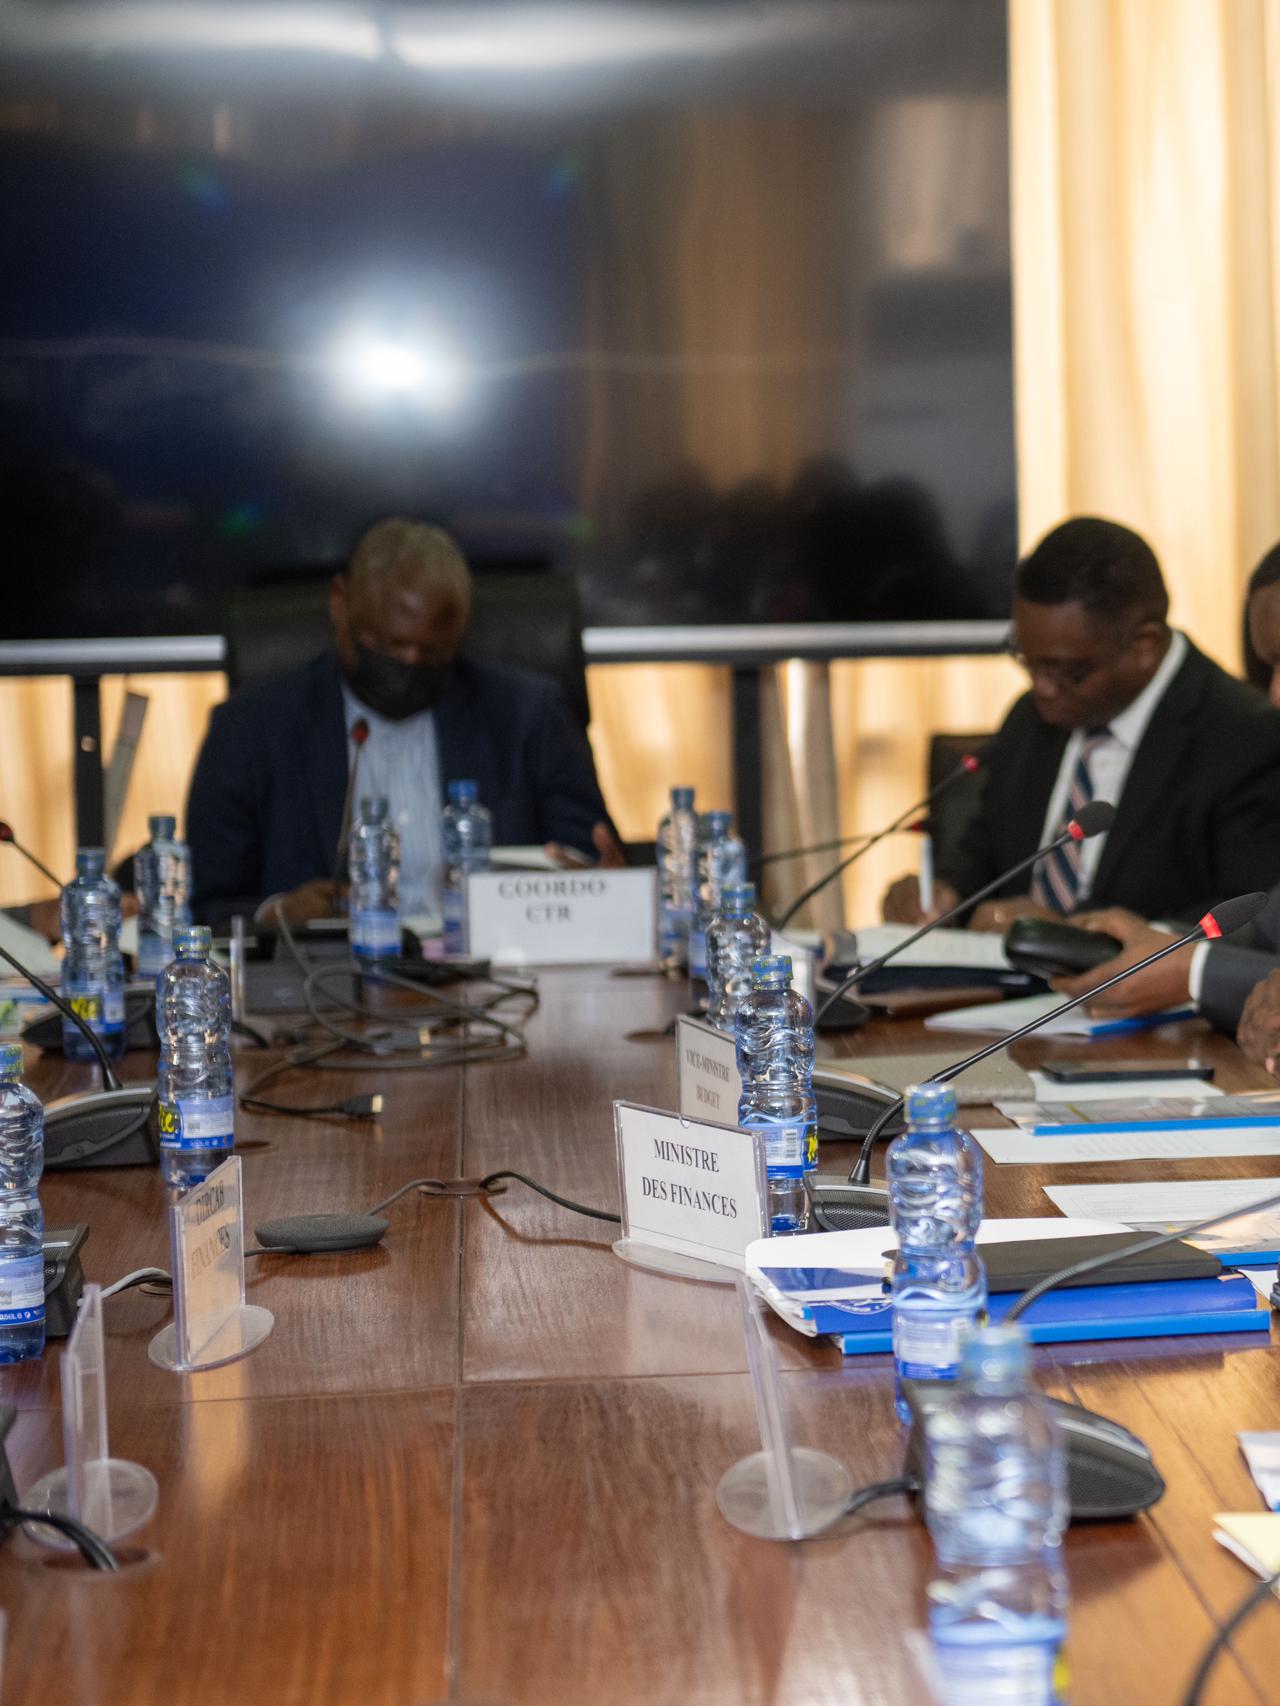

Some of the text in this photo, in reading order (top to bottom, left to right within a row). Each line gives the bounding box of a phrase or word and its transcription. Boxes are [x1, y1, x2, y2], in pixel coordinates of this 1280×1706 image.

[498, 878, 606, 899] COORDO
[526, 903, 571, 923] CTR
[685, 1049, 730, 1083] VICE-MINISTRE
[696, 1085, 720, 1111] BUDGET
[654, 1139, 719, 1173] MINISTRE
[642, 1176, 737, 1219] DES FINANCES
